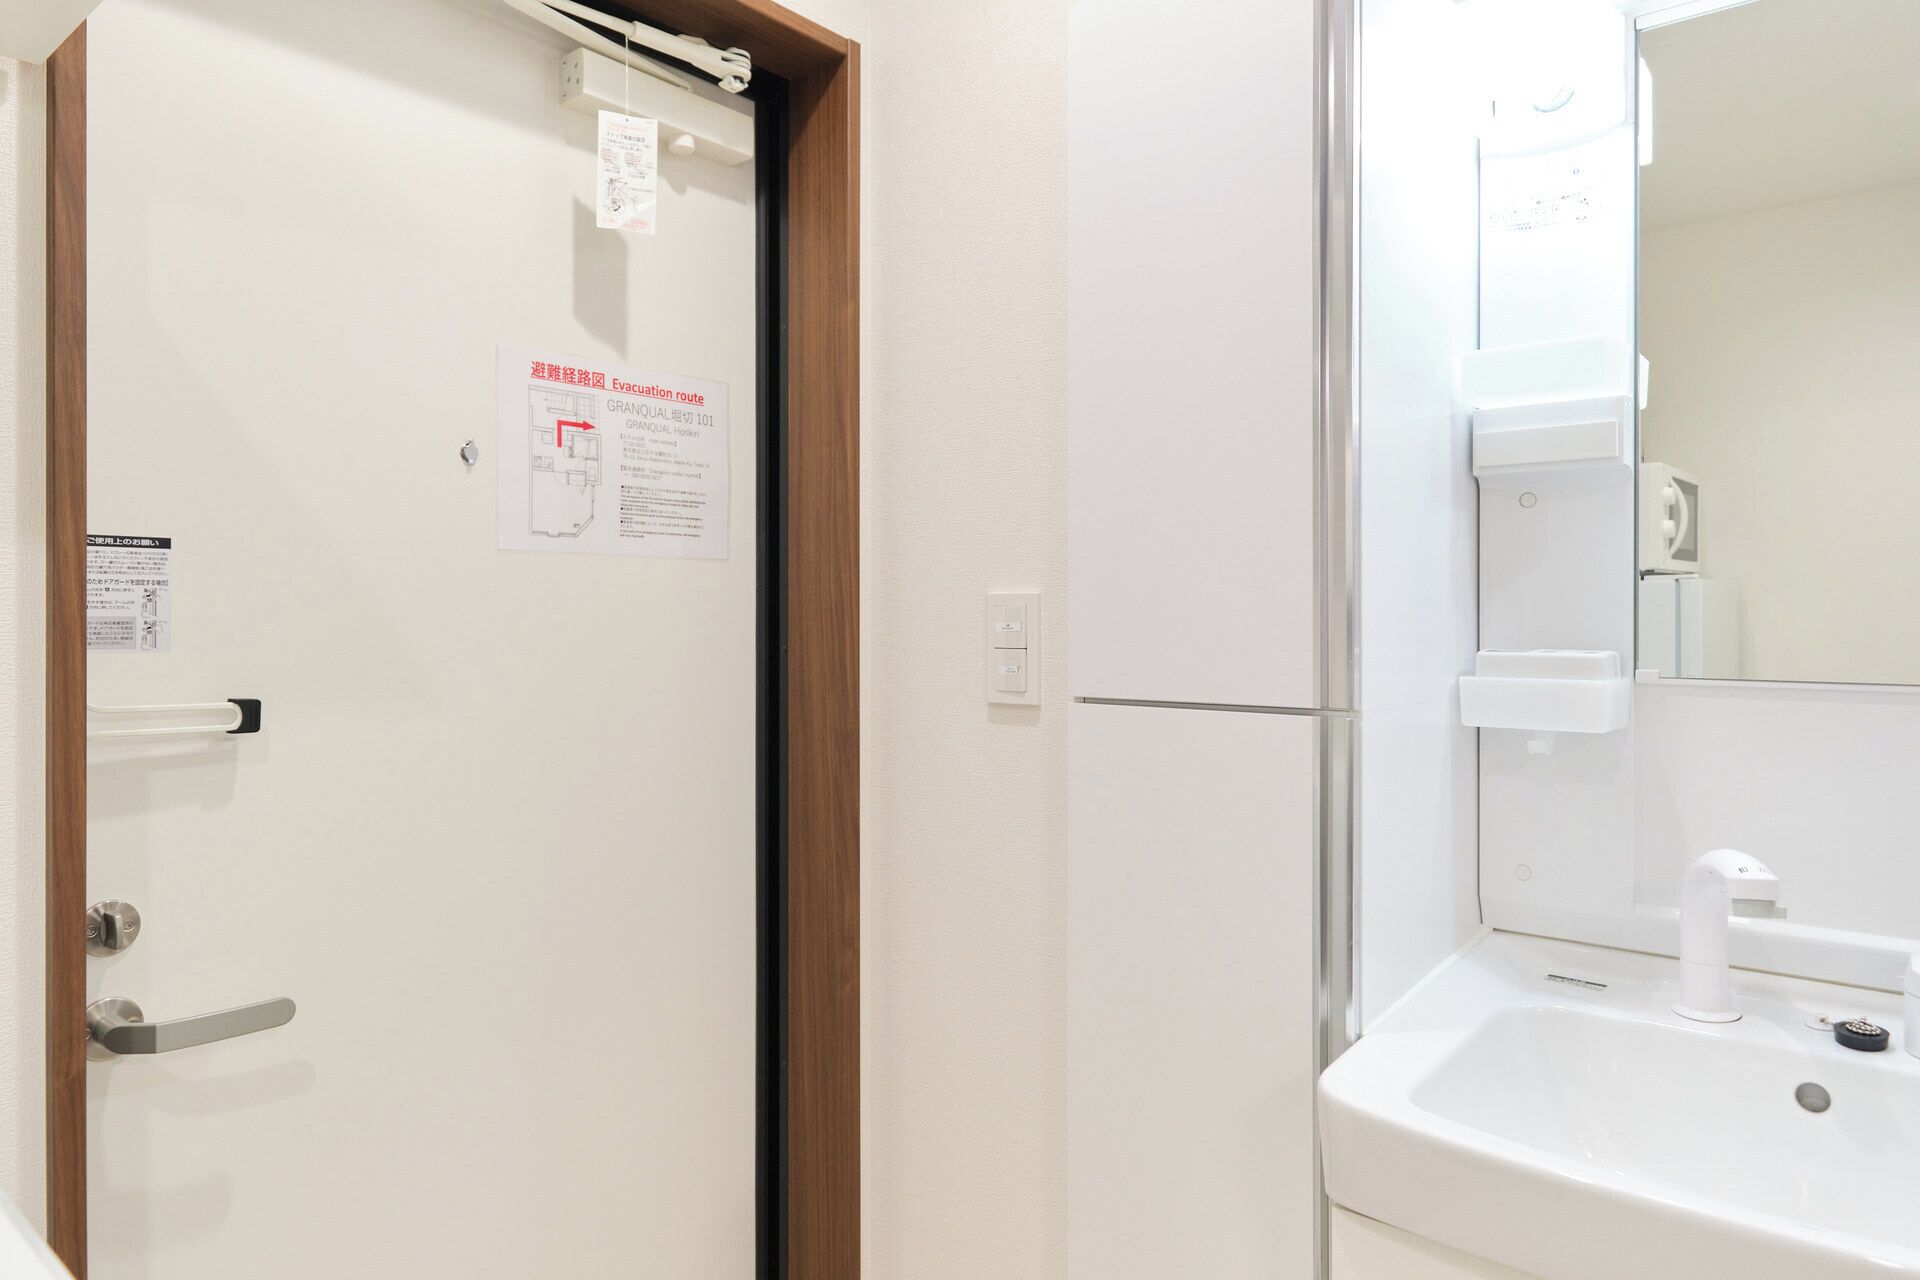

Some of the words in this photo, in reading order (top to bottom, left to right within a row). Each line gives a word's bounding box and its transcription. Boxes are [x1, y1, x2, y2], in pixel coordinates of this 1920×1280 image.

[530, 360, 605, 389] 避難経路図
[612, 378, 673, 399] Evacuation
[675, 391, 705, 405] route
[606, 398, 694, 424] GRANQUAL堀切
[696, 413, 714, 427] 101
[626, 418, 673, 435] GRANQUAL
[674, 427, 700, 438] Horikiri
[87, 537, 160, 546] ご使用上のお願い
